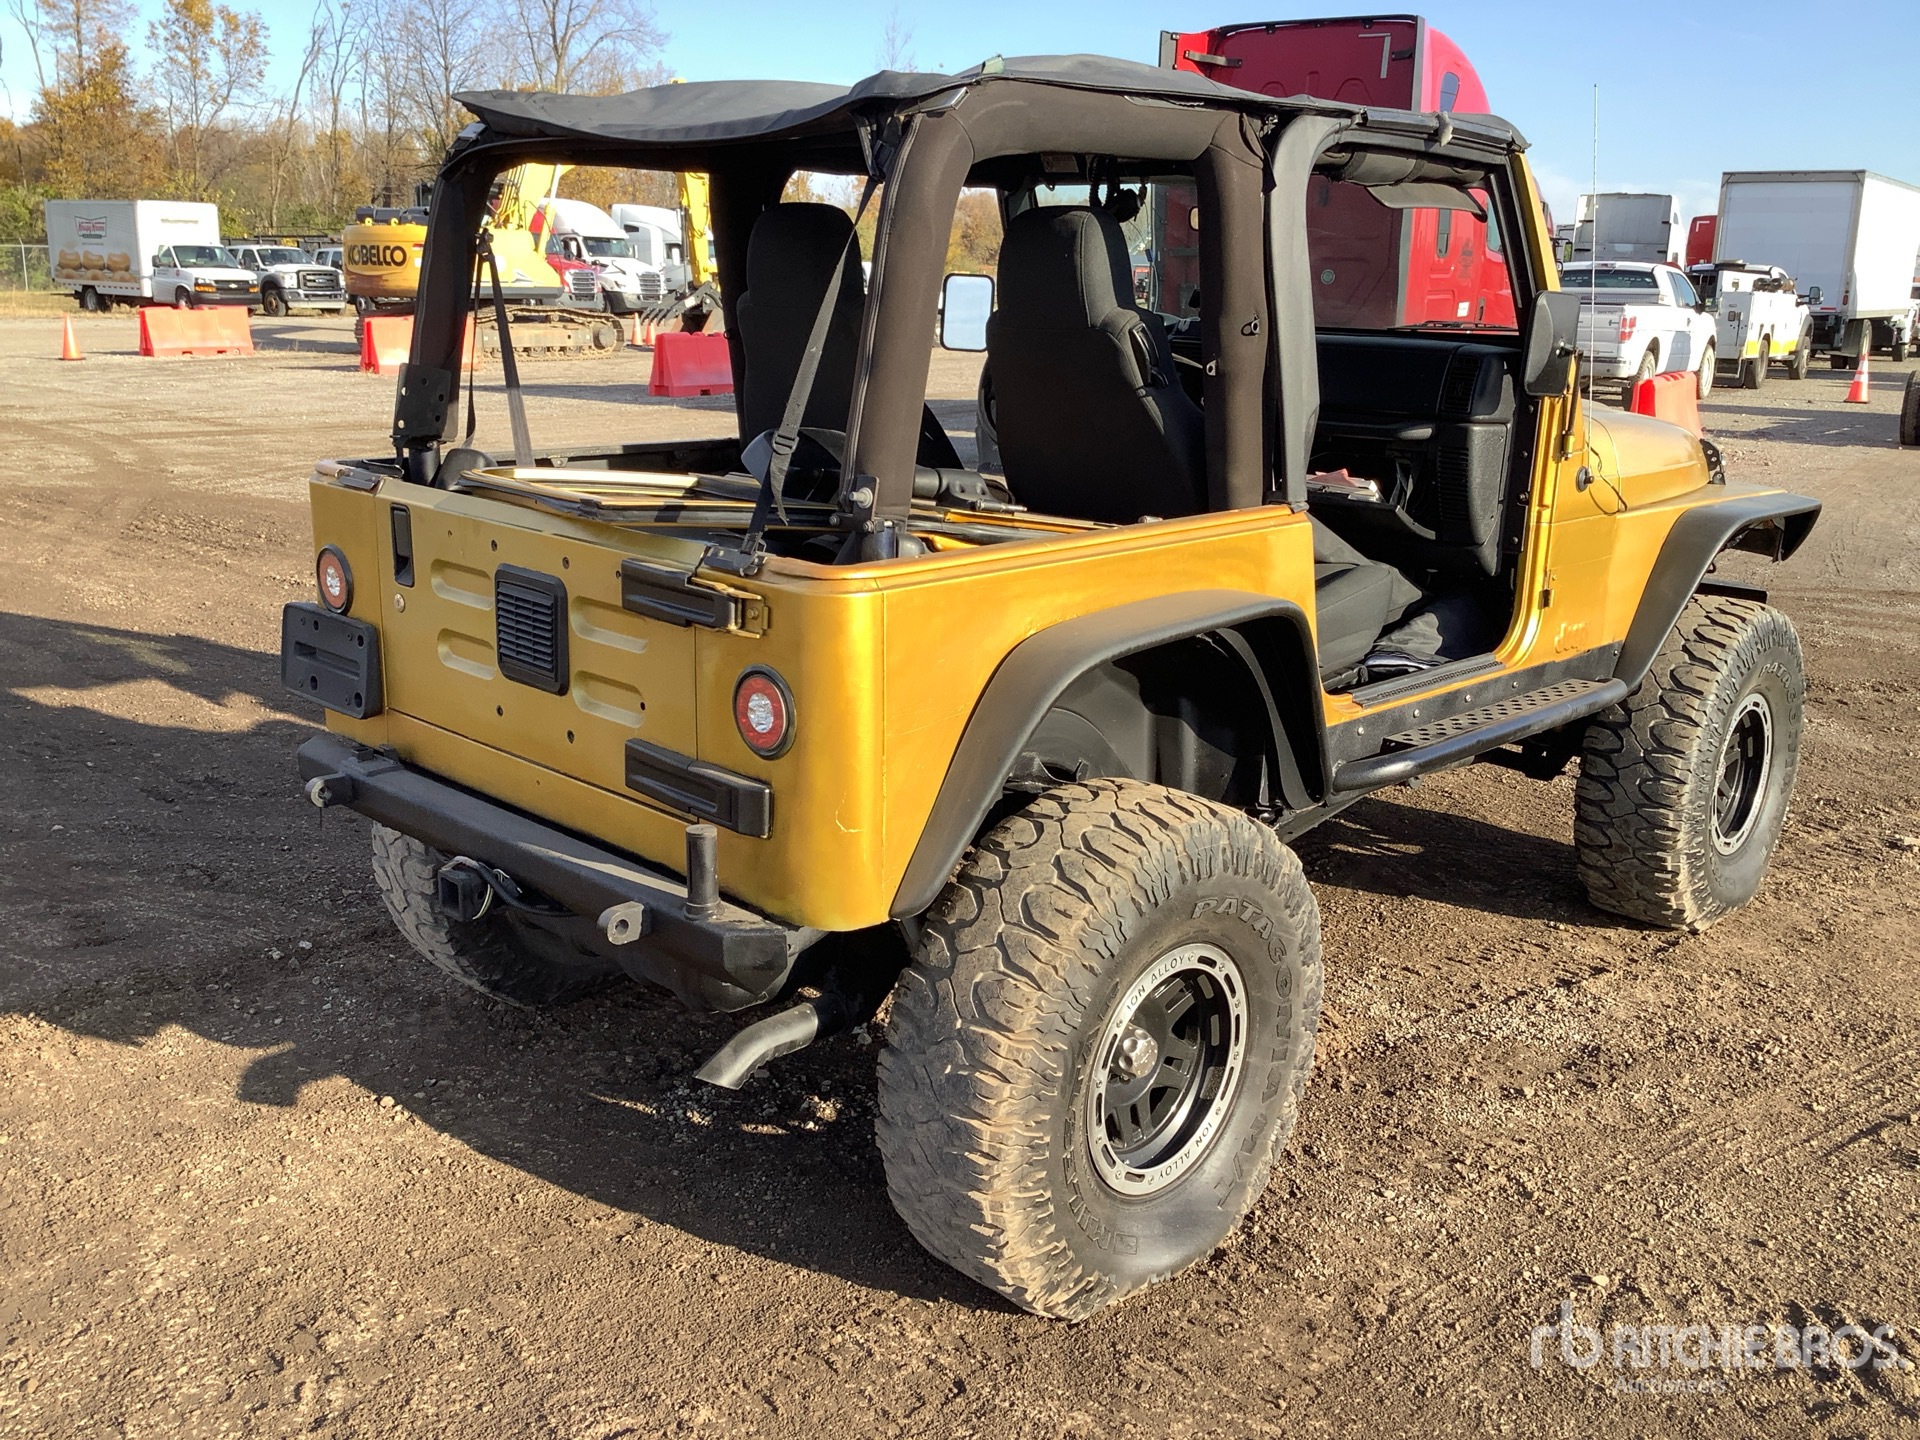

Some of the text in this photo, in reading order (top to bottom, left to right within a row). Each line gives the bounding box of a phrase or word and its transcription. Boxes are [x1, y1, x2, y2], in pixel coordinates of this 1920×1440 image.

[347, 244, 407, 267] KOBELCO
[1126, 954, 1185, 1012] ION ALLOY
[1190, 897, 1293, 1105] PATAGONIA
[1158, 1122, 1213, 1180] ION ALLOY
